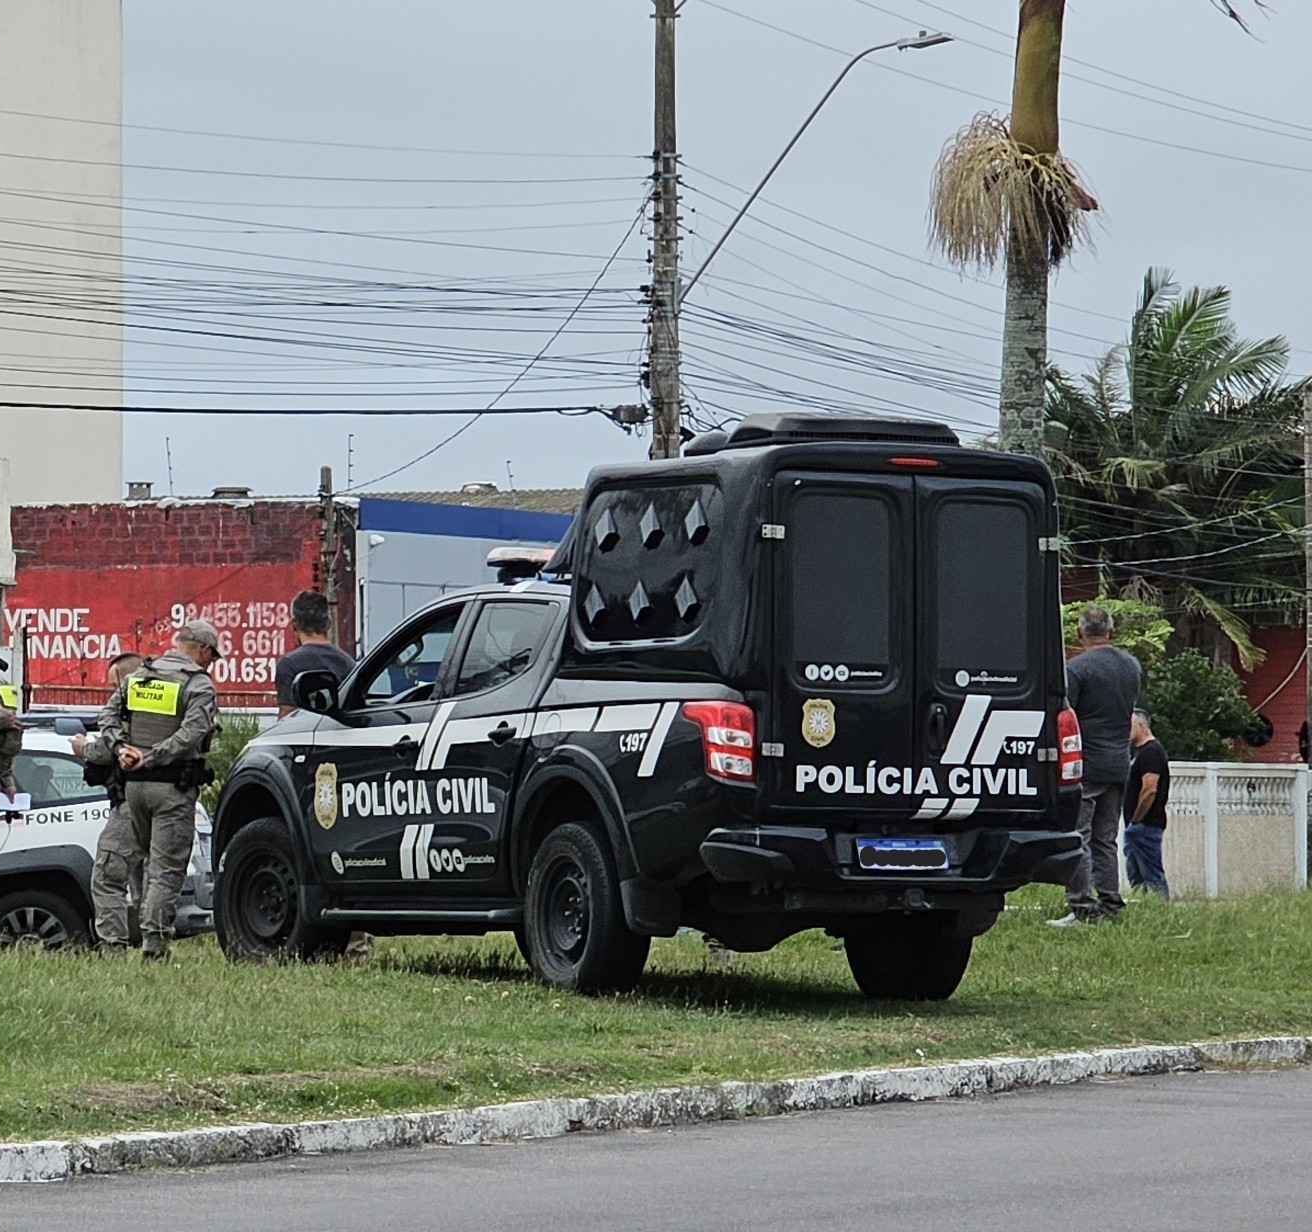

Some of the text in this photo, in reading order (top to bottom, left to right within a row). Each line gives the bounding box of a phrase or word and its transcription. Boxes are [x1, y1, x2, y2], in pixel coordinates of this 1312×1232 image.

[3, 608, 90, 633] VENDE
[8, 634, 122, 660] INANCIA
[207, 657, 277, 683] 01.631
[625, 732, 648, 751] 197
[1010, 740, 1035, 755] 197
[795, 760, 1037, 796] POLÍCIA CIVIL
[341, 772, 496, 818] POLÍCIA CIVIL
[25, 807, 111, 826] FONE 190
